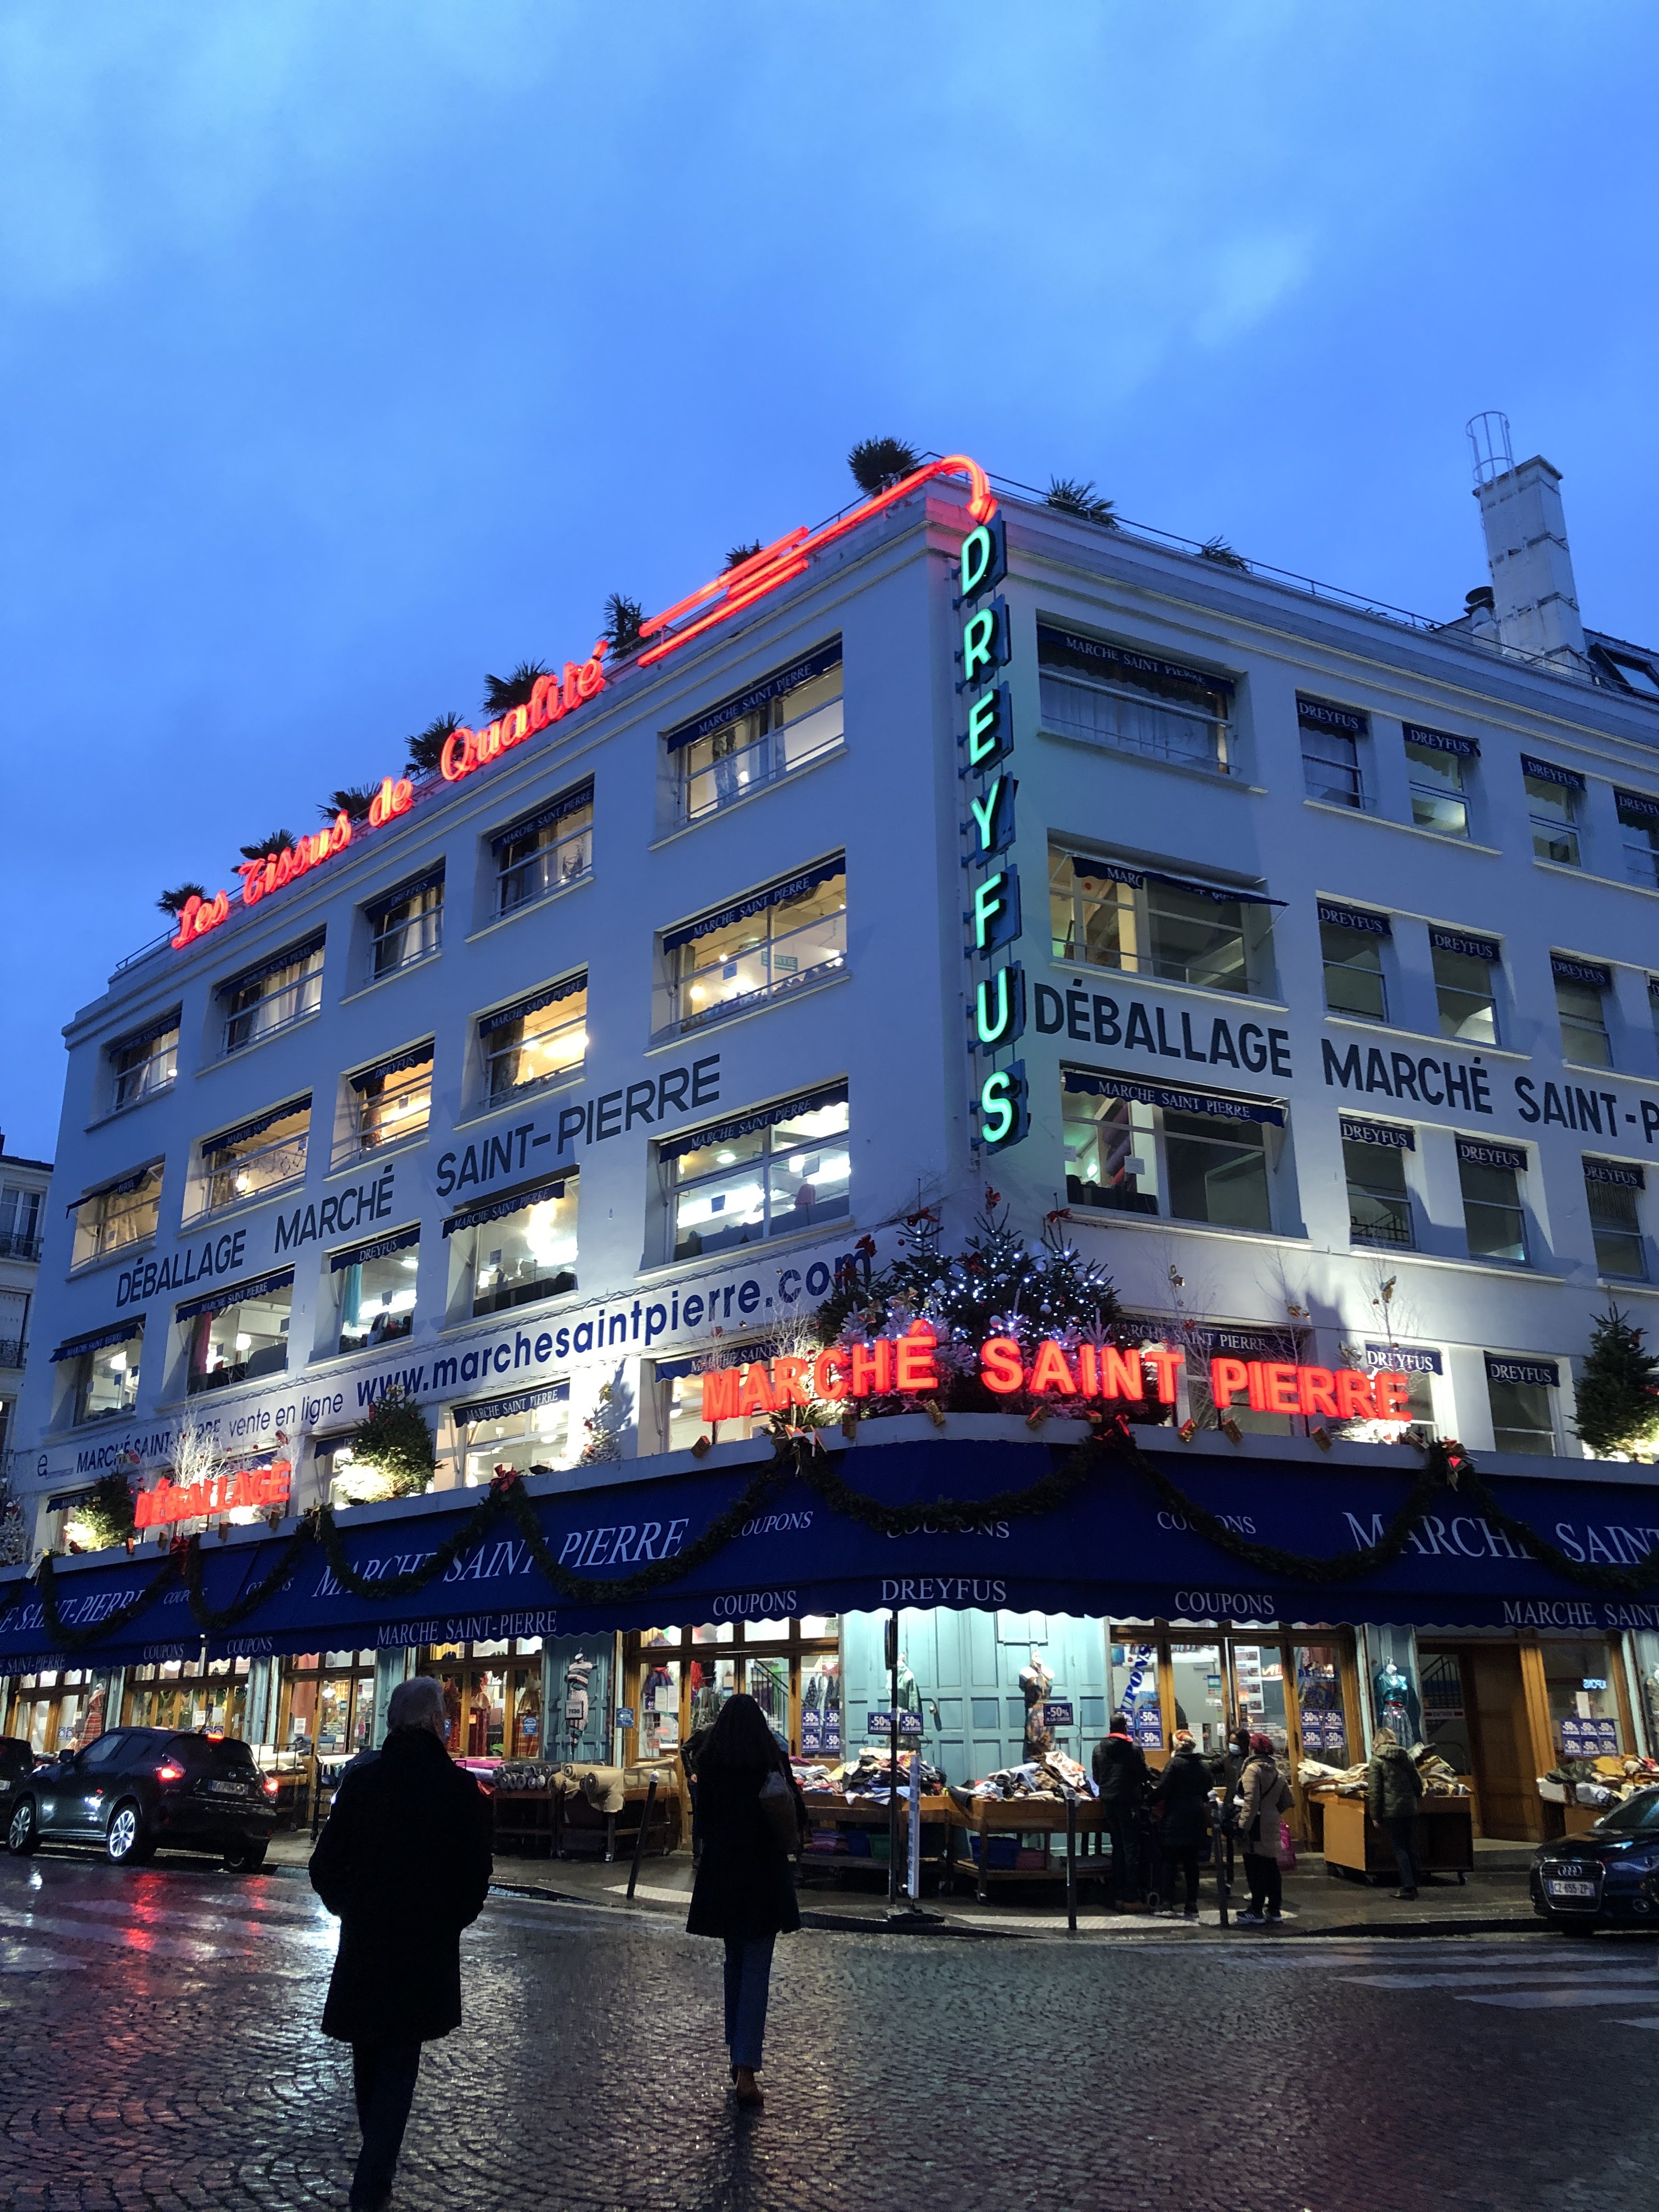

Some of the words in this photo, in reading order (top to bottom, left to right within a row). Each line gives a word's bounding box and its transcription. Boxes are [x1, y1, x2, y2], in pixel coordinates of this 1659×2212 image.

[1066, 636, 1119, 661] MARCHE
[1123, 655, 1159, 672] SAINT
[699, 704, 738, 734] MARCHE
[742, 687, 772, 710] SAINT
[776, 664, 812, 691] PIERRE
[1299, 702, 1359, 730] DREYFUS
[1410, 729, 1471, 753] DREYFUS
[1527, 760, 1579, 787] DREYFUS
[171, 890, 229, 950] Les
[238, 809, 352, 906] Tissus
[369, 776, 414, 828] de
[441, 640, 610, 782] Qualité
[961, 525, 1014, 1143] DREYFUS
[1107, 867, 1143, 888] MARC
[693, 910, 735, 937] MARCHE
[740, 895, 769, 918] SAINT
[774, 877, 810, 901] PIERRE
[1320, 907, 1383, 933] DREYFUS
[1435, 933, 1493, 958] DREYFUS
[762, 952, 797, 966] SRTIE
[1551, 960, 1606, 984] DREYFUS
[490, 1006, 524, 1029] MARCHE
[526, 994, 551, 1012] SAINT
[1034, 978, 1294, 1079] DÉBALLAGE
[1321, 1037, 1493, 1115] MARCHÉ
[374, 1055, 415, 1079] DREYFUS
[1098, 1081, 1156, 1104] MARCHE
[1162, 1092, 1200, 1111] SAINT
[1206, 1098, 1251, 1119] PIERRE
[691, 1125, 735, 1150] MARCHE
[739, 1113, 771, 1135] SAINT
[775, 1098, 812, 1122] PIERRE
[1342, 1122, 1408, 1147] DREYFUS
[1461, 1145, 1520, 1167] DREYFUS
[116, 1229, 247, 1308] DÉBALLAGE
[274, 1164, 394, 1254] MARCHÉ
[436, 1053, 720, 1198] SAINT-PIERRE
[1583, 1165, 1638, 1185] DREYFUS
[453, 1207, 489, 1230] MARCHE
[492, 1198, 516, 1217] SAINT
[520, 1187, 550, 1208] PIERRE
[359, 1239, 397, 1262] DREYFUS
[1220, 1334, 1267, 1352] PIERRE
[702, 1319, 938, 1422] MARCHÉ
[981, 1337, 1184, 1404] SAINT
[1211, 1357, 1413, 1421] PIERRE
[1490, 1363, 1553, 1383] DREYFUS
[228, 1408, 271, 1438] vente
[275, 1404, 296, 1427] en
[301, 1392, 344, 1425] ligne
[466, 1404, 500, 1421] MARCHE
[503, 1398, 527, 1415] SAINT
[530, 1389, 558, 1408] PIERRE
[134, 1461, 292, 1528] DÉBALLAGE
[557, 1518, 690, 1569] PIERRE
[881, 1578, 1007, 1602] DREYFUS
[713, 1590, 797, 1616] COUPONS
[1175, 1591, 1276, 1615] COUPONS
[1503, 1601, 1597, 1626] MARCHE
[377, 1620, 439, 1647] MARCHE
[445, 1610, 558, 1641] SAINT-PIERRE
[144, 1643, 185, 1660] COUPONS
[227, 1637, 274, 1655] COUPONS
[803, 1712, 819, 1722] -50%
[871, 1716, 891, 1726] -50%
[902, 1716, 921, 1726] -50%
[1047, 1707, 1069, 1717] -50%
[1140, 1712, 1159, 1722] -50%
[1302, 1712, 1319, 1722] -50%
[1325, 1713, 1342, 1722] -50%
[803, 1735, 819, 1745] -50%
[1141, 1733, 1160, 1742] -50%
[1304, 1732, 1321, 1741] -50%
[1326, 1733, 1343, 1742] -50%
